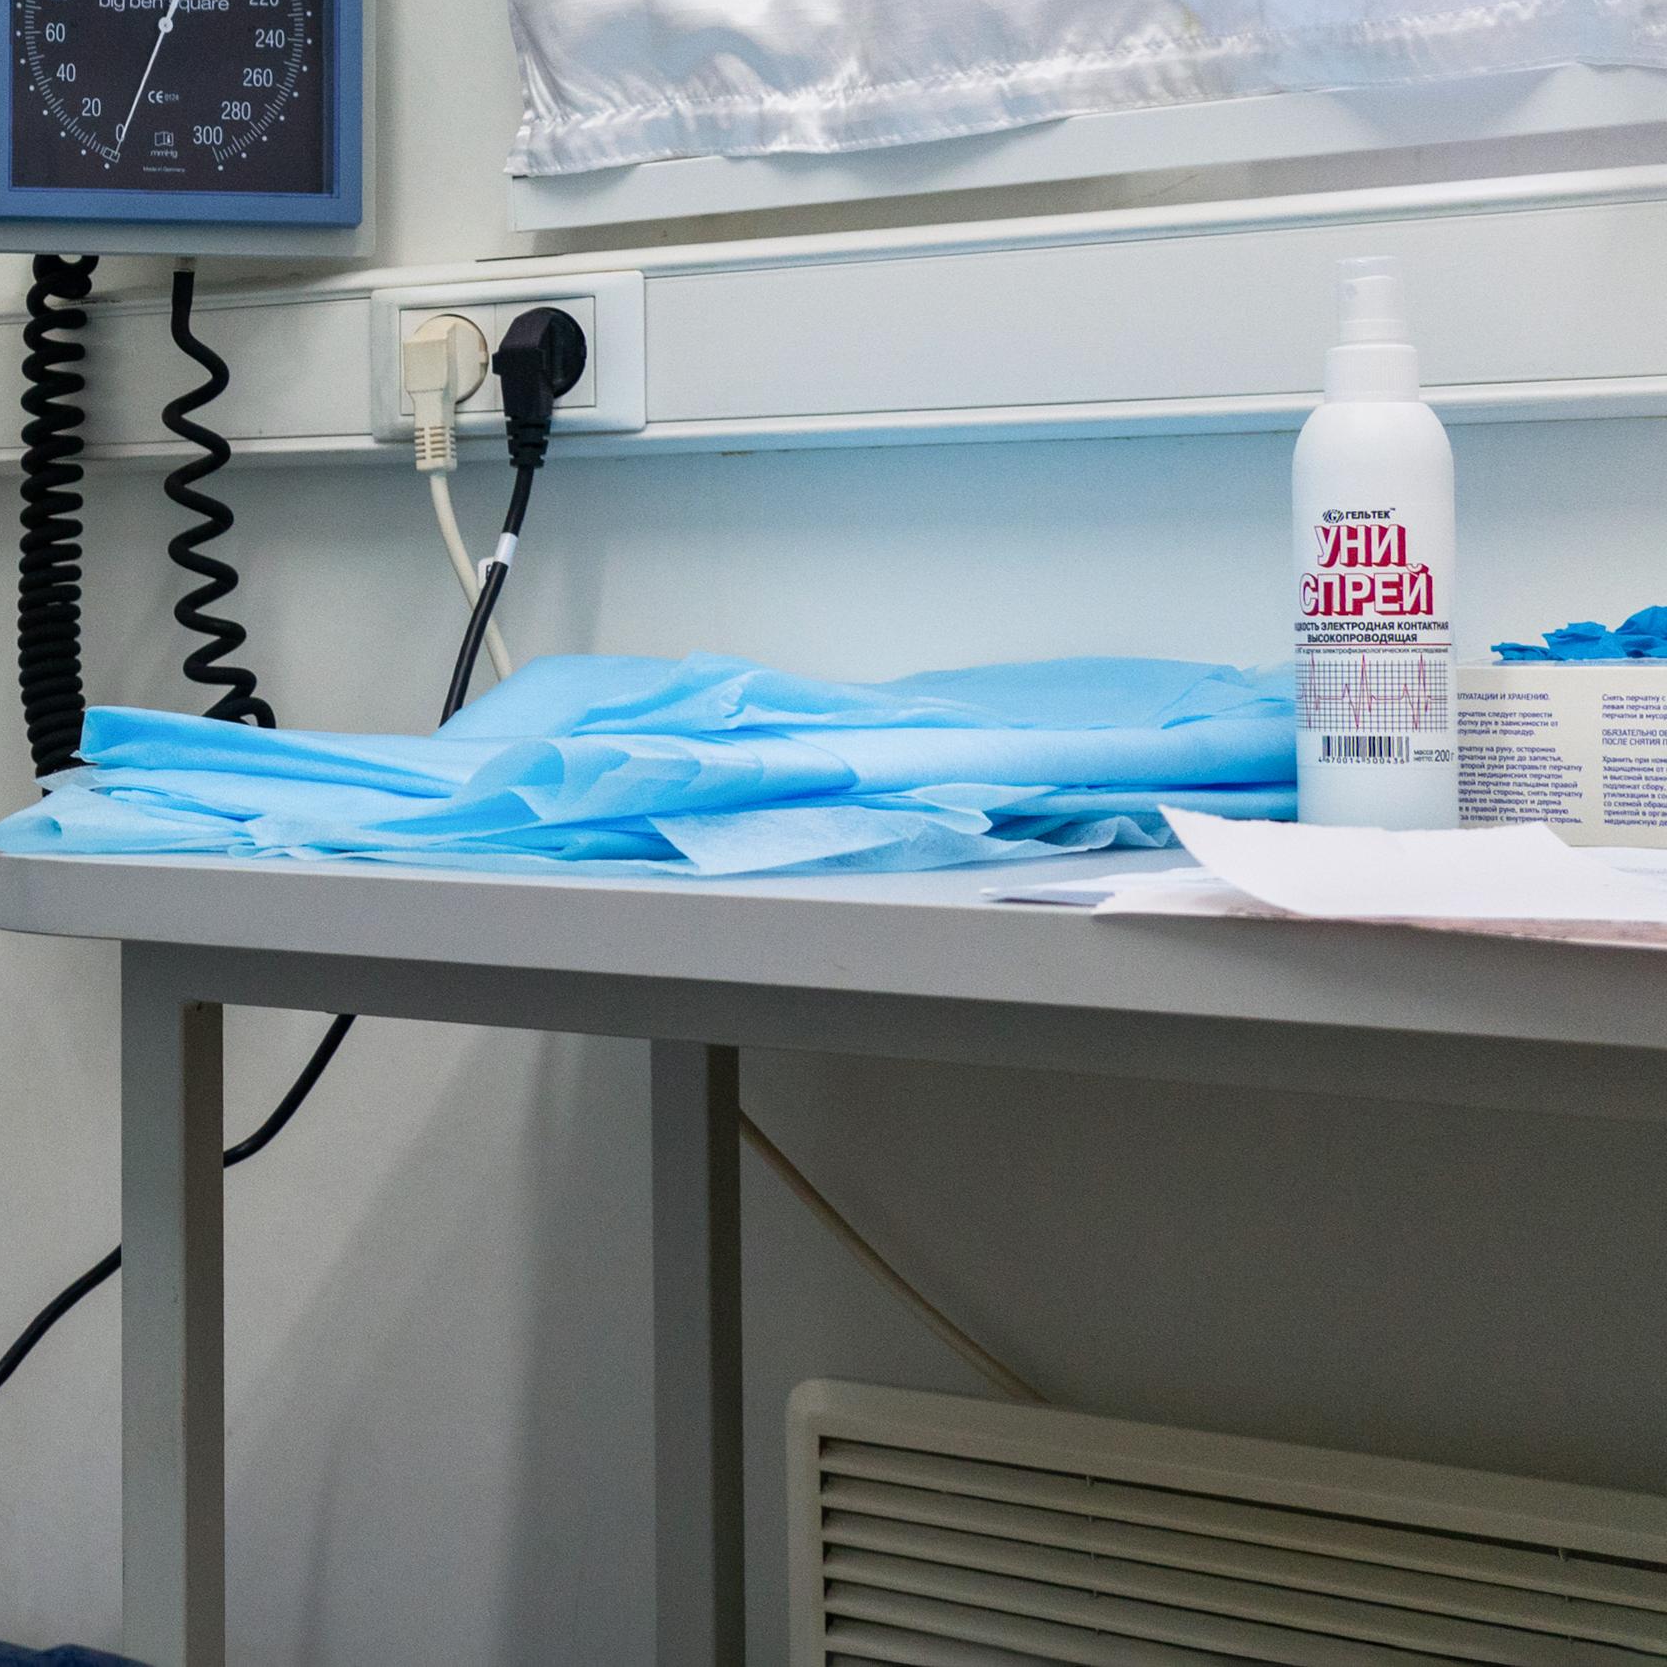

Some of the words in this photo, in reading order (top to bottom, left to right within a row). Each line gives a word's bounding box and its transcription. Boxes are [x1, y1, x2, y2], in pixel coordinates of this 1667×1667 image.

[45, 23, 66, 42] 60
[255, 29, 286, 49] 240
[56, 63, 77, 83] 40
[243, 68, 273, 87] 260
[81, 97, 101, 117] 20
[221, 101, 251, 120] 280
[115, 123, 126, 143] 0
[193, 125, 223, 145] 300
[150, 150, 178, 159] mmHg
[1345, 510, 1391, 520] ГЕЛЬТЕК
[1314, 524, 1406, 568] УНИ
[1299, 563, 1434, 616] СПРЕЙ
[1321, 621, 1395, 632] ЭЛЕКТРОДНАЯ
[1397, 620, 1449, 631] КОНТАКТНАЯ
[1307, 632, 1418, 644] ВЫСОКОПРОВОДЯЩАЯ
[1602, 693, 1624, 701] Снять
[1602, 728, 1657, 736] ОБЯЗАТЕЛЬНО
[1602, 737, 1627, 745] ПОСЛЕ
[1434, 748, 1450, 762] 200
[1604, 818, 1657, 826] медицинскую
